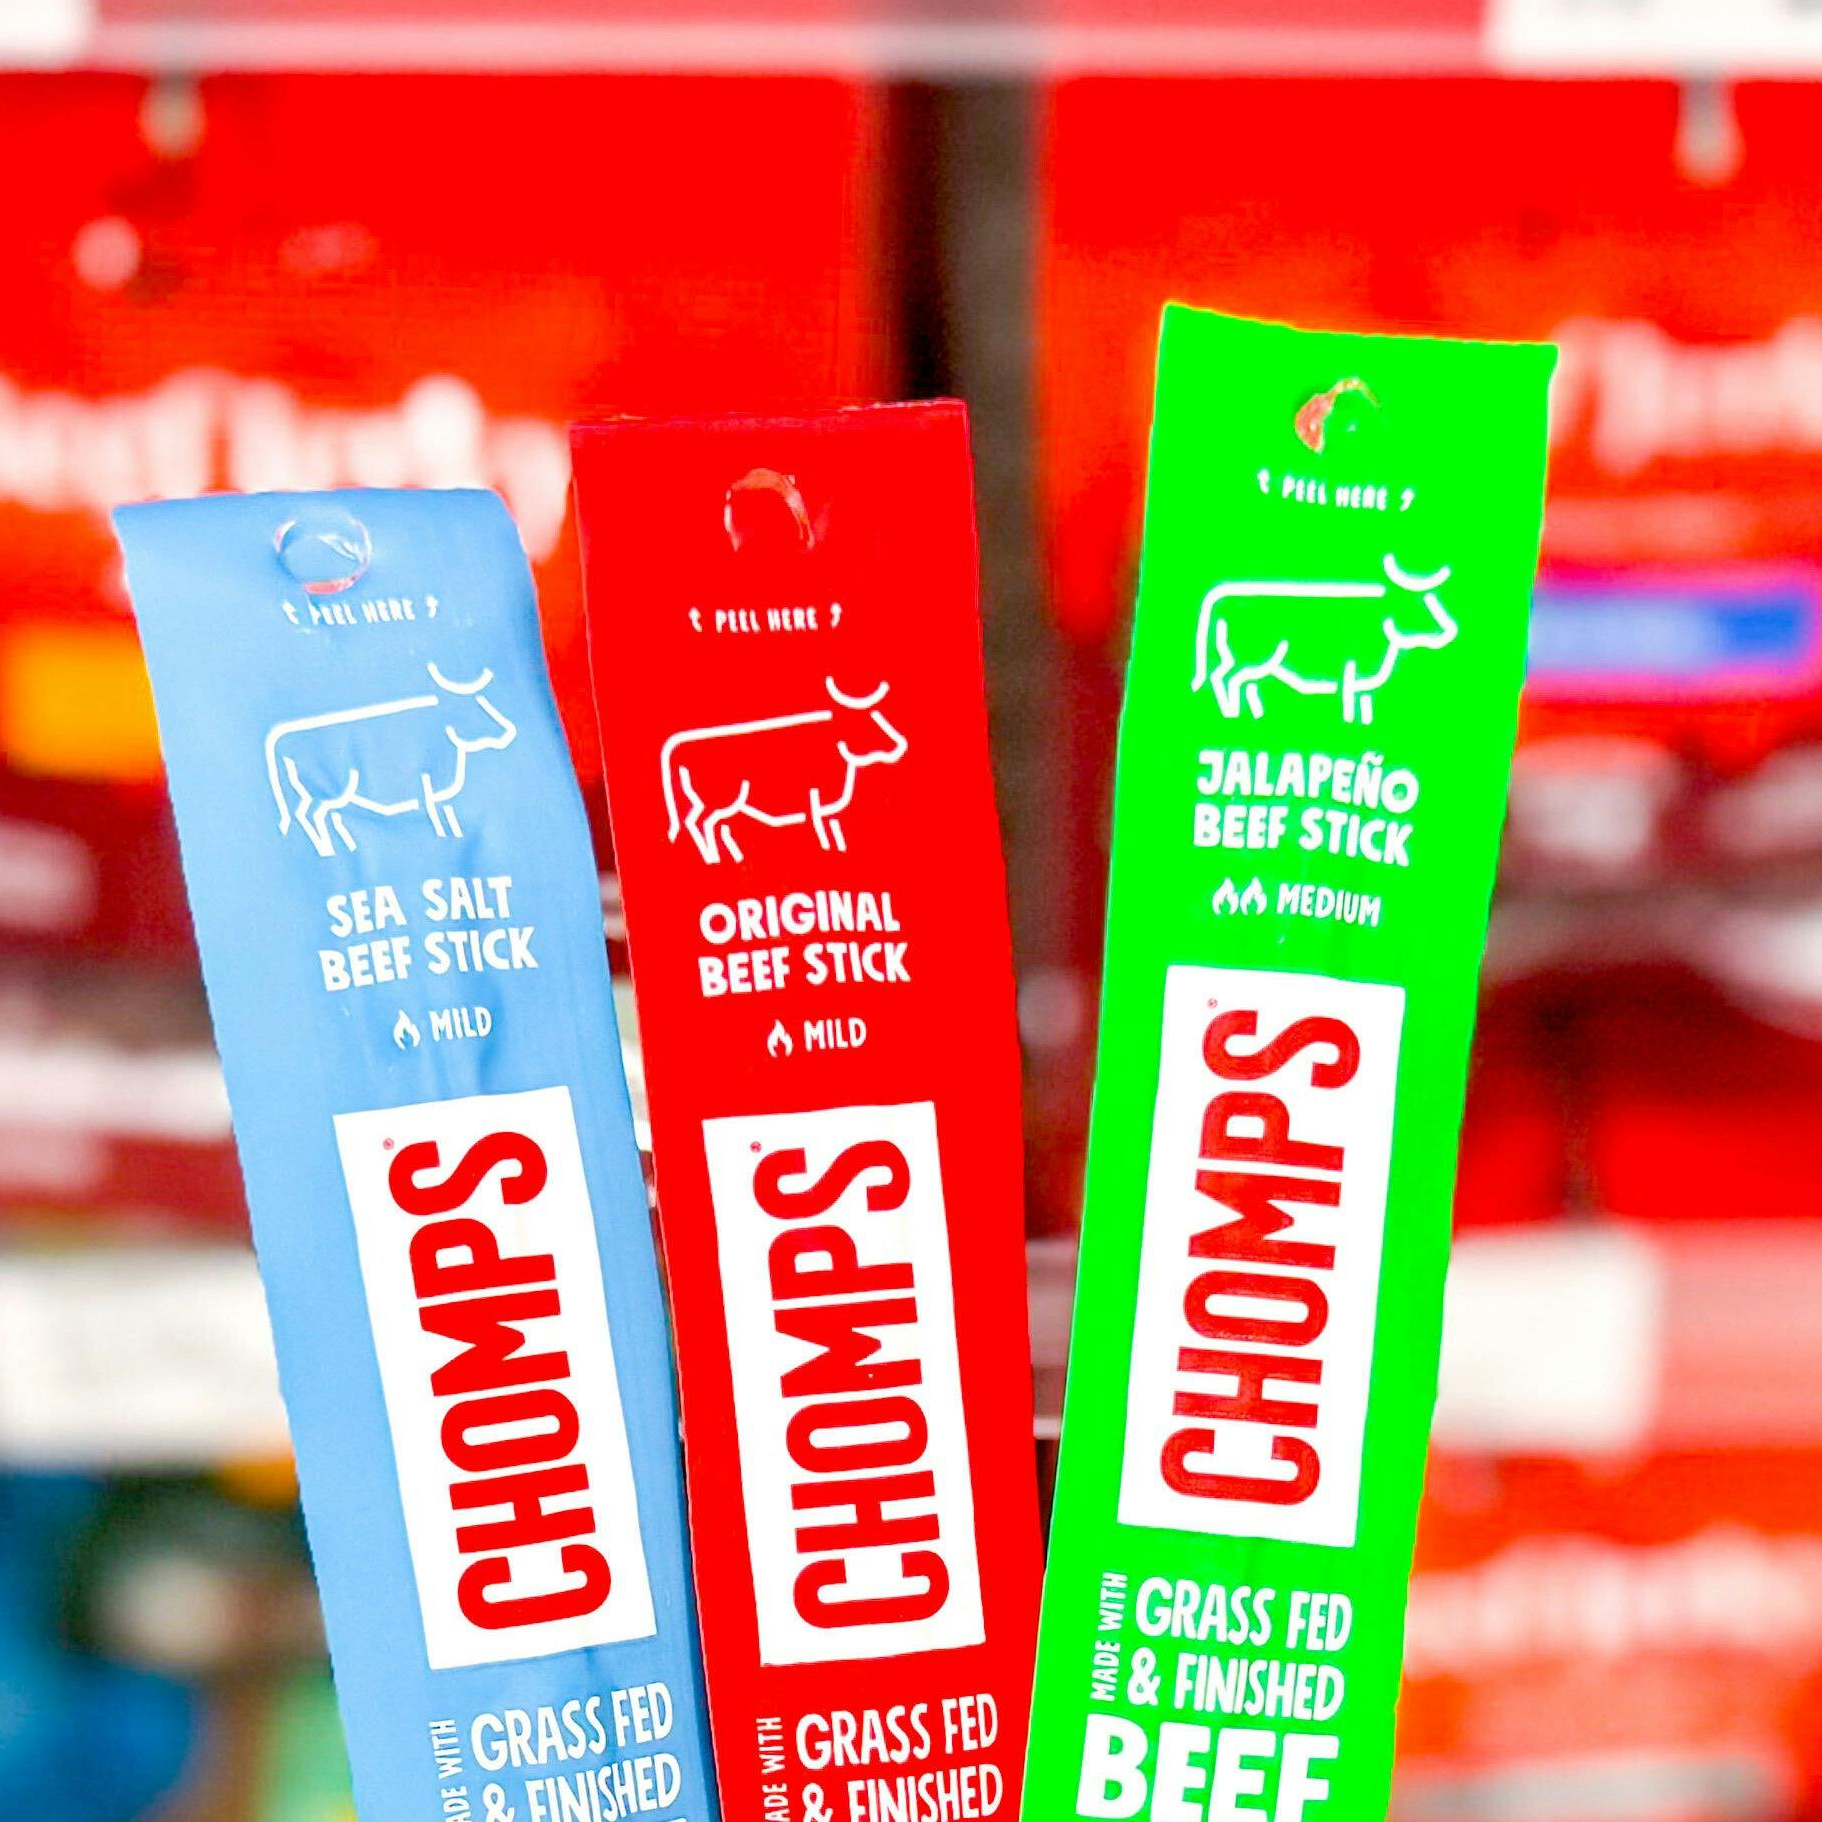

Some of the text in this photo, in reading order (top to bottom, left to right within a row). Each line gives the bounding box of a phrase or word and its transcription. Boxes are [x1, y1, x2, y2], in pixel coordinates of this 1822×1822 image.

[1281, 476, 1387, 511] PEEL HERE
[362, 597, 416, 623] HERE
[715, 607, 819, 633] PEEL HERE
[1197, 750, 1419, 814] JALAPEÑO
[1193, 803, 1414, 867] BEEF STICK
[326, 876, 512, 938] SEA SALT
[700, 890, 900, 944] ORIGINAL
[1276, 883, 1381, 928] MEDIUM
[319, 926, 538, 992] BEEF STICK
[698, 942, 911, 997] BEEF STICK
[429, 1006, 492, 1042] MILD
[804, 1017, 867, 1052] MILD
[1160, 1009, 1361, 1506] CHOMPS
[388, 1131, 611, 1630] CHOMPS
[752, 1139, 950, 1628] CHOMPS
[1090, 1572, 1127, 1701] MADE WITH
[1135, 1576, 1276, 1646] GRASS
[1286, 1590, 1352, 1651] FED
[1127, 1647, 1344, 1721] & FINISHED
[429, 1719, 463, 1779] WITH
[471, 1682, 673, 1771] GRASS FED
[756, 1716, 785, 1774] WITH
[796, 1693, 998, 1770] GRASS FED
